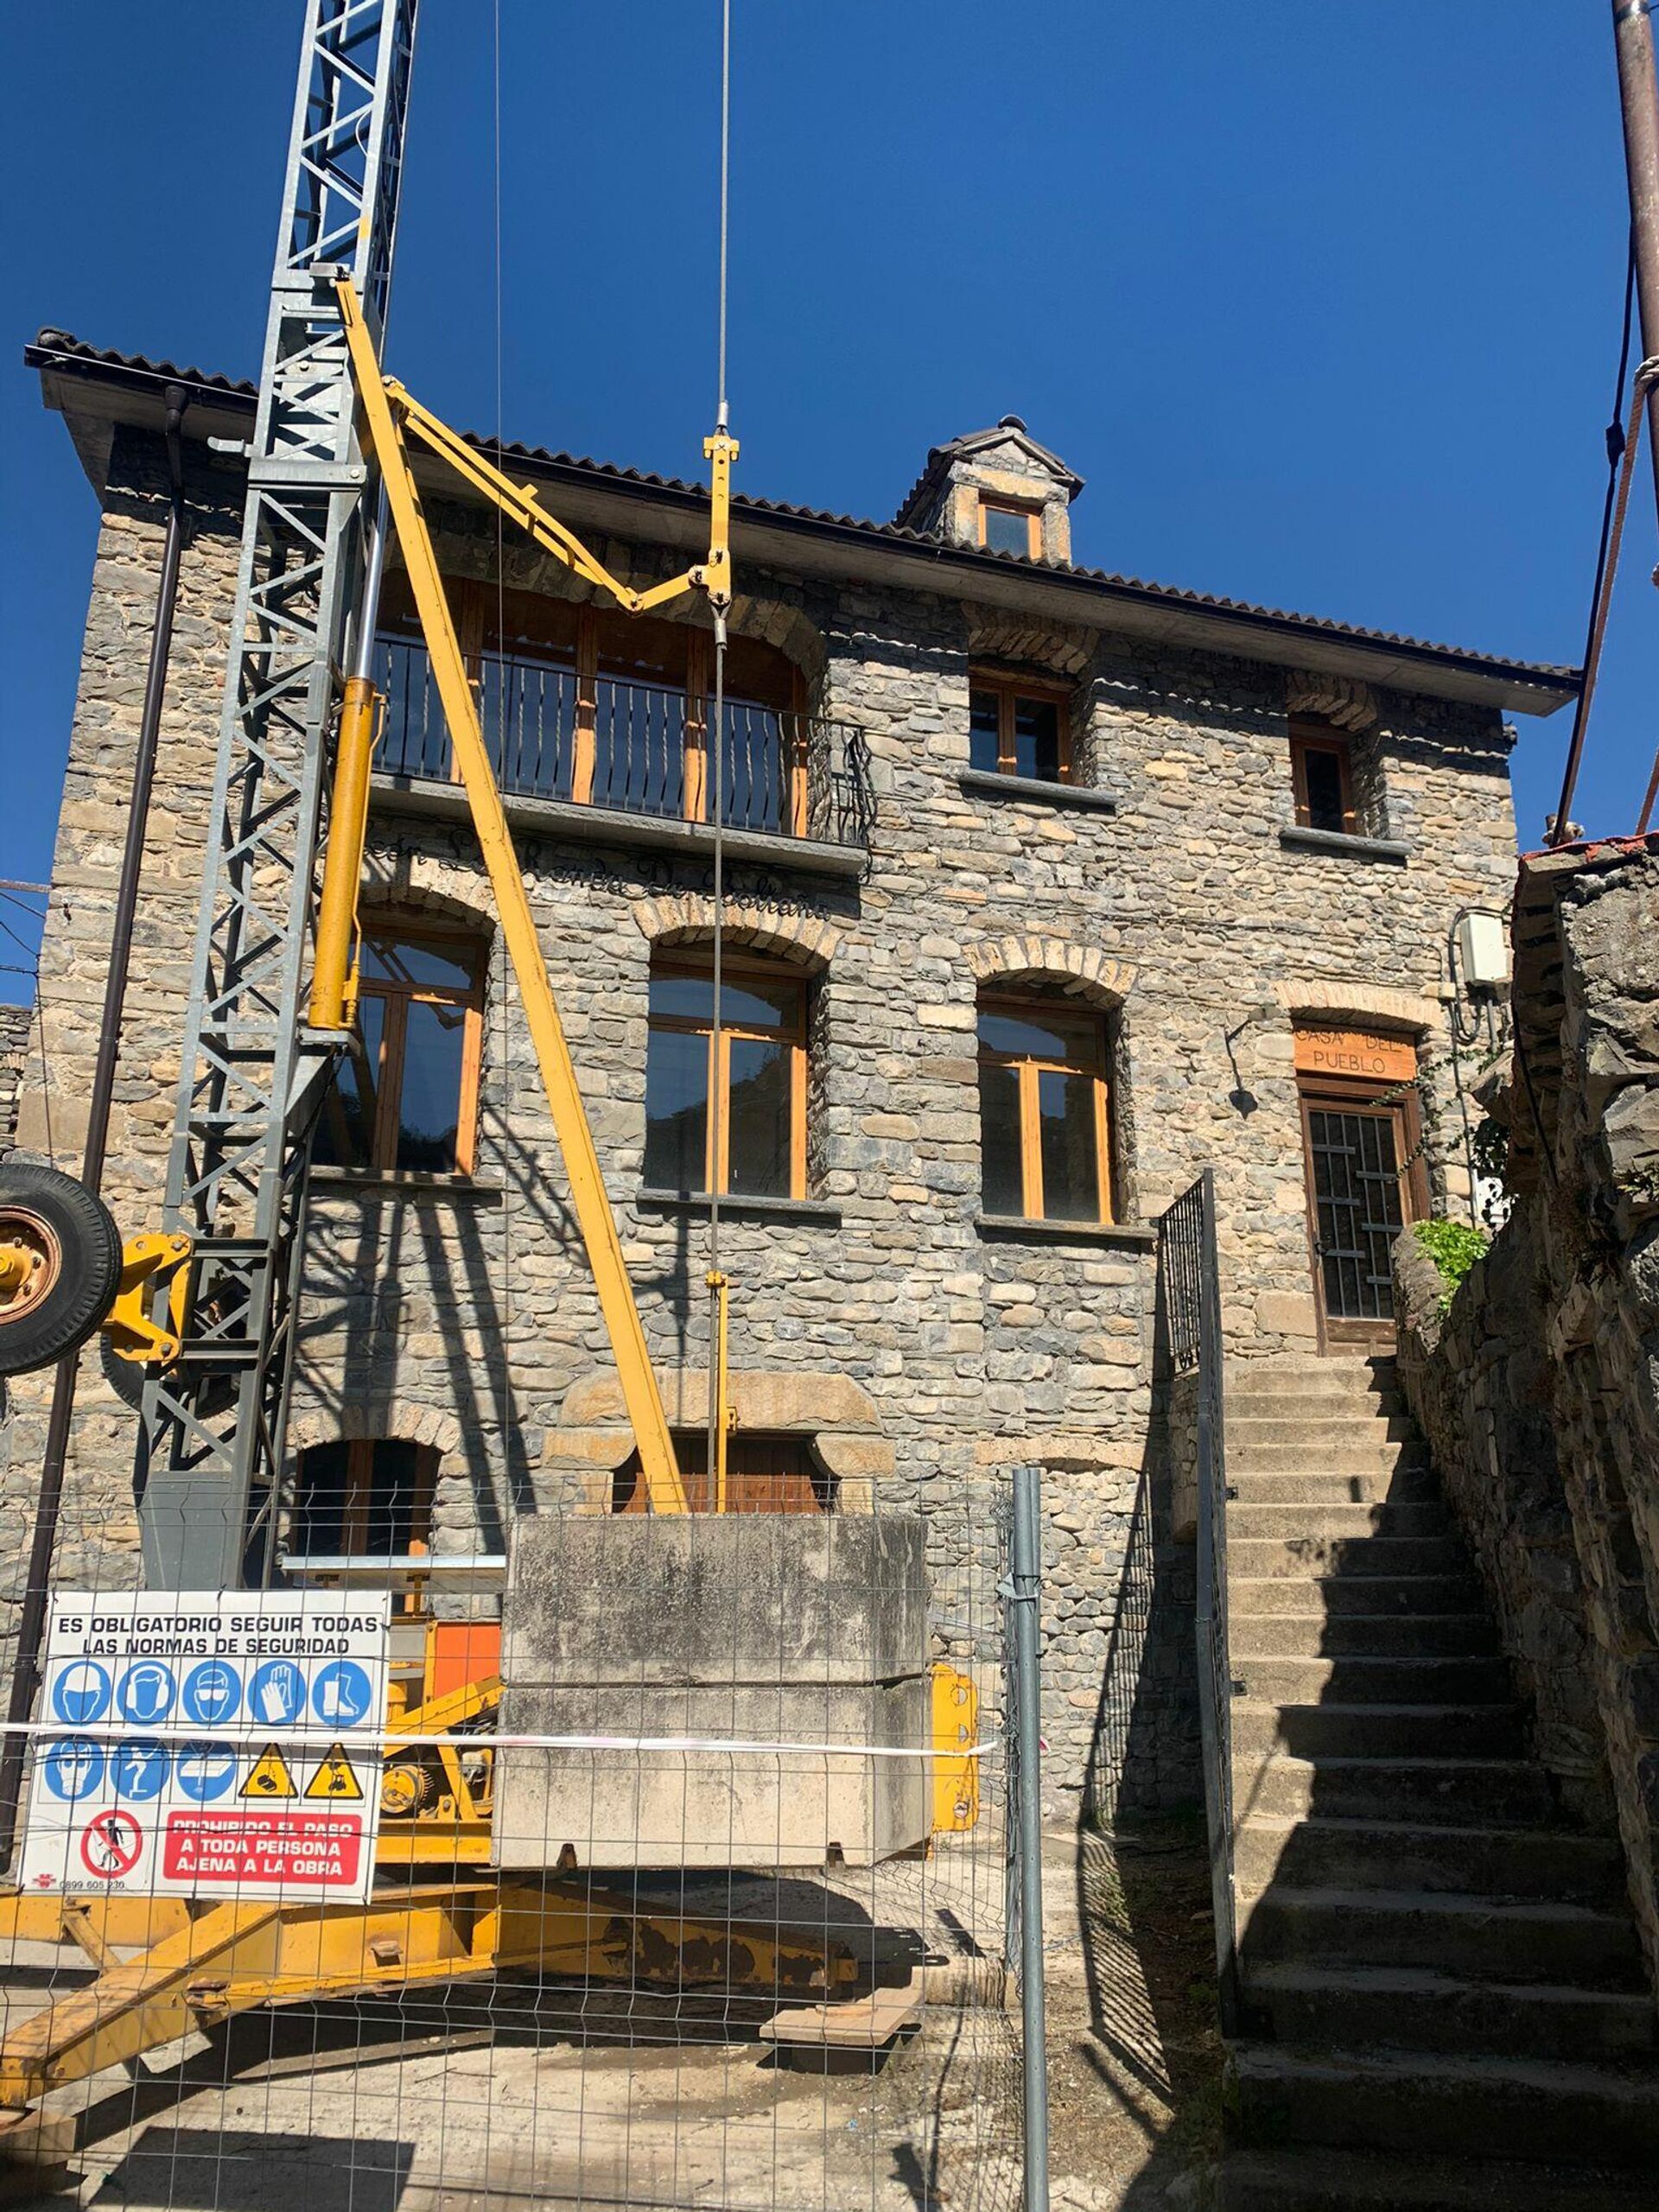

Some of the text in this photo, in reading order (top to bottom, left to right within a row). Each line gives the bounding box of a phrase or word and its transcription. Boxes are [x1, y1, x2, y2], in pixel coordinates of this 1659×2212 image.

[1296, 1027, 1402, 1053] CASA DEL
[1313, 1051, 1386, 1073] PUEBLO
[59, 1617, 378, 1633] ES OBLIGATORIO SEGUIR TODAS
[83, 1638, 350, 1654] LAS NORMAS DE SEGURIDAD
[173, 1819, 353, 1838] PROHIBIDO EL PASO
[180, 1839, 341, 1857] A TODA PERSONA
[175, 1857, 342, 1875] AJENA A LA OBRA
[86, 1880, 105, 1889] 605
